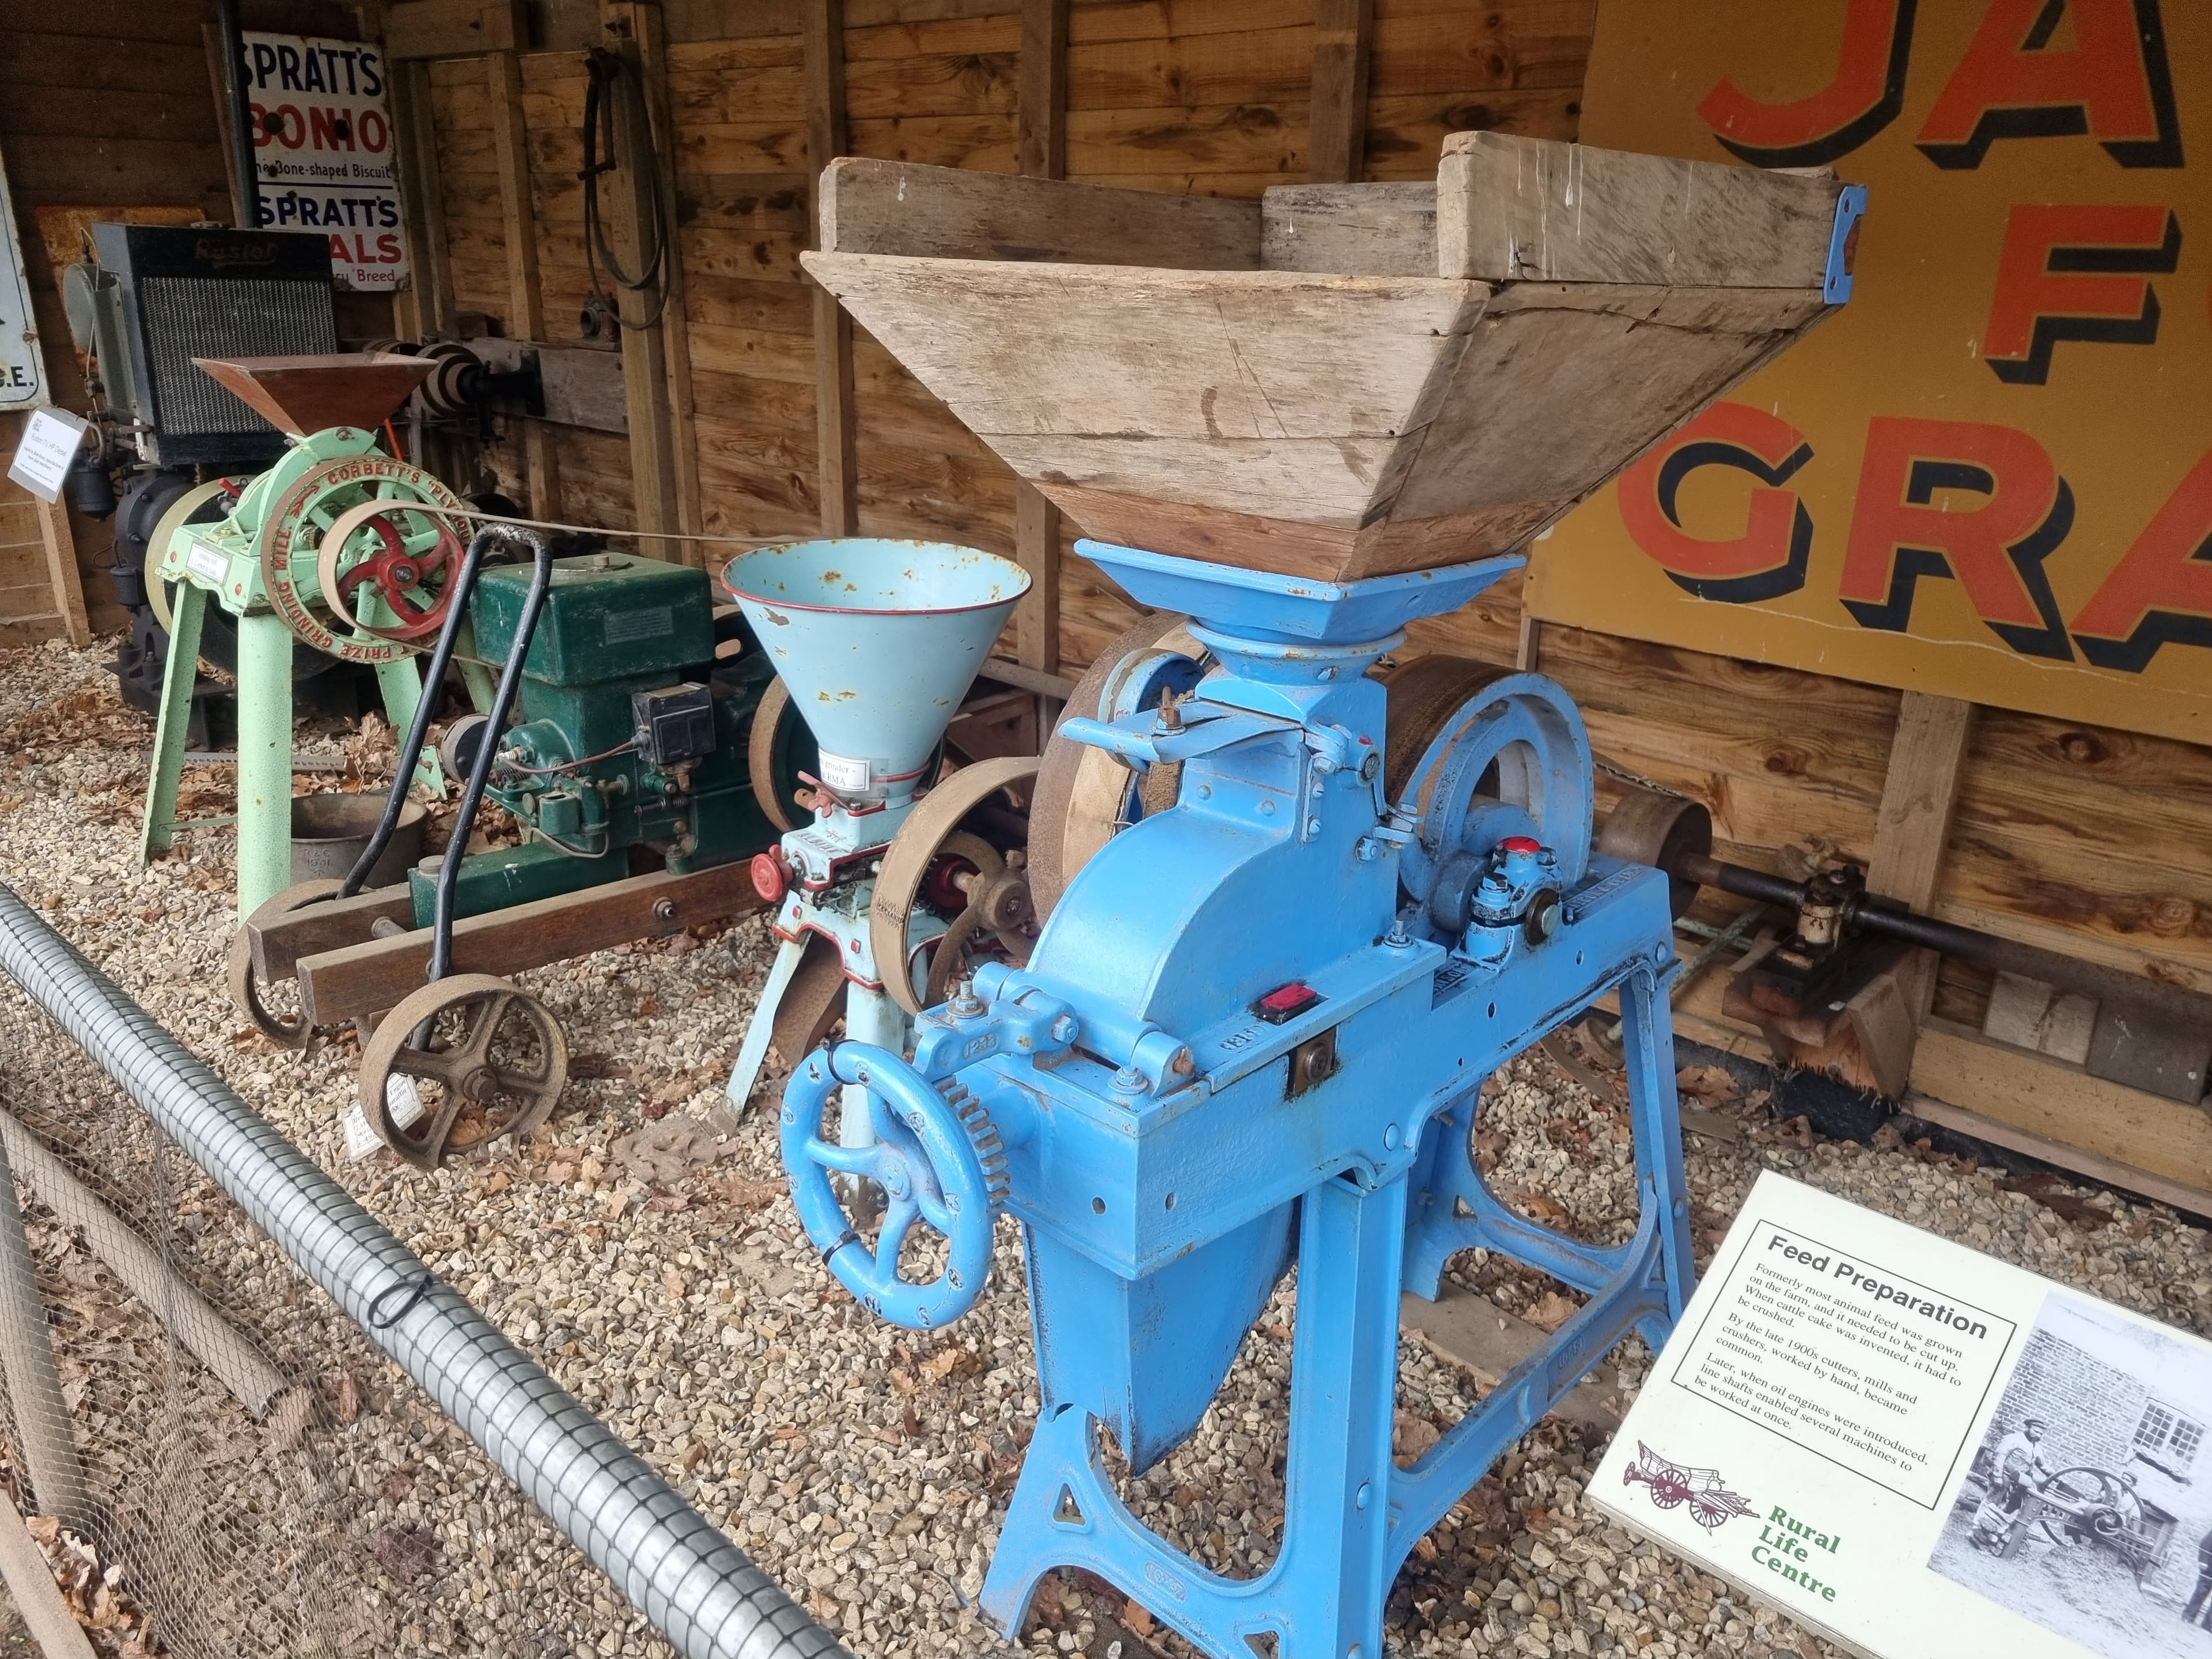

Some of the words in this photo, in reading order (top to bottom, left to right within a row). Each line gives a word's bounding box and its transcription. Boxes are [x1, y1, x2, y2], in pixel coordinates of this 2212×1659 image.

[249, 102, 388, 153] BONIO
[275, 160, 348, 180] Bone-shaped
[353, 163, 391, 179] Biscuit
[259, 196, 399, 227] SPRATT'S
[330, 233, 402, 264] ALS
[357, 268, 395, 282] Breed
[1985, 205, 2212, 385] F
[327, 463, 421, 484] CORBETT'S
[277, 581, 333, 649] GRINDING
[340, 642, 391, 659] PRIZE
[827, 772, 846, 786] RMA
[389, 1080, 407, 1096] Engine
[1737, 1294, 1751, 1308] be
[1752, 1304, 1795, 1328] crushed.
[1755, 1262, 1804, 1290] Formerly
[1804, 1285, 1832, 1302] most
[1833, 1298, 1872, 1319] animal
[1873, 1313, 1899, 1331] feed
[1902, 1326, 1923, 1342] was
[1923, 1338, 1963, 1359] grown
[1767, 1234, 1831, 1272] Feed
[1833, 1262, 1987, 1340] Preparation
[1745, 1283, 1775, 1305] When
[1776, 1301, 1806, 1318] cattle
[1807, 1315, 1833, 1330] cake
[1836, 1326, 1858, 1341] was
[1858, 1335, 1910, 1366] invented,
[1912, 1358, 1923, 1370] it
[1924, 1363, 1948, 1381] had
[1949, 1376, 1962, 1387] to
[1749, 1275, 1763, 1286] on
[1764, 1281, 1782, 1294] the
[1782, 1288, 1811, 1308] farm,
[1813, 1303, 1836, 1317] and
[1835, 1310, 1846, 1322] it
[1846, 1317, 1888, 1340] needed
[1888, 1335, 1901, 1346] to
[1903, 1339, 1918, 1353] be
[1919, 1350, 1939, 1363] cut
[1940, 1358, 1959, 1372] up.
[1715, 1336, 1763, 1364] common.
[1722, 1325, 1767, 1353] crushers,
[1771, 1347, 1813, 1372] worked
[1813, 1365, 1828, 1380] by
[1829, 1372, 1860, 1396] hand,
[1863, 1388, 1908, 1415] became
[1727, 1311, 1744, 1327] By
[1745, 1321, 1763, 1334] the
[1763, 1328, 1785, 1344] late
[1787, 1339, 1820, 1360] 1900s
[1820, 1357, 1861, 1381] cutters,
[1863, 1376, 1894, 1394] mills
[1895, 1390, 1918, 1405] and
[1694, 1374, 1708, 1388] be
[1710, 1383, 1751, 1408] worked
[1750, 1404, 1762, 1415] at
[1763, 1411, 1792, 1430] once.
[1700, 1362, 1721, 1379] line
[1721, 1375, 1754, 1396] shafts
[1755, 1392, 1800, 1417] enabled
[1799, 1413, 1842, 1438] several
[1841, 1433, 1898, 1465] machines
[1899, 1460, 1912, 1472] to
[1705, 1351, 1736, 1374] Later,
[1740, 1369, 1769, 1388] when
[1770, 1384, 1787, 1397] oil
[1787, 1392, 1831, 1418] engines
[1834, 1414, 1862, 1432] were
[1862, 1426, 1928, 1466] introduced,
[1759, 1525, 1808, 1562] Life
[1768, 1505, 1841, 1554] Rural
[1752, 1546, 1836, 1603] Centre
